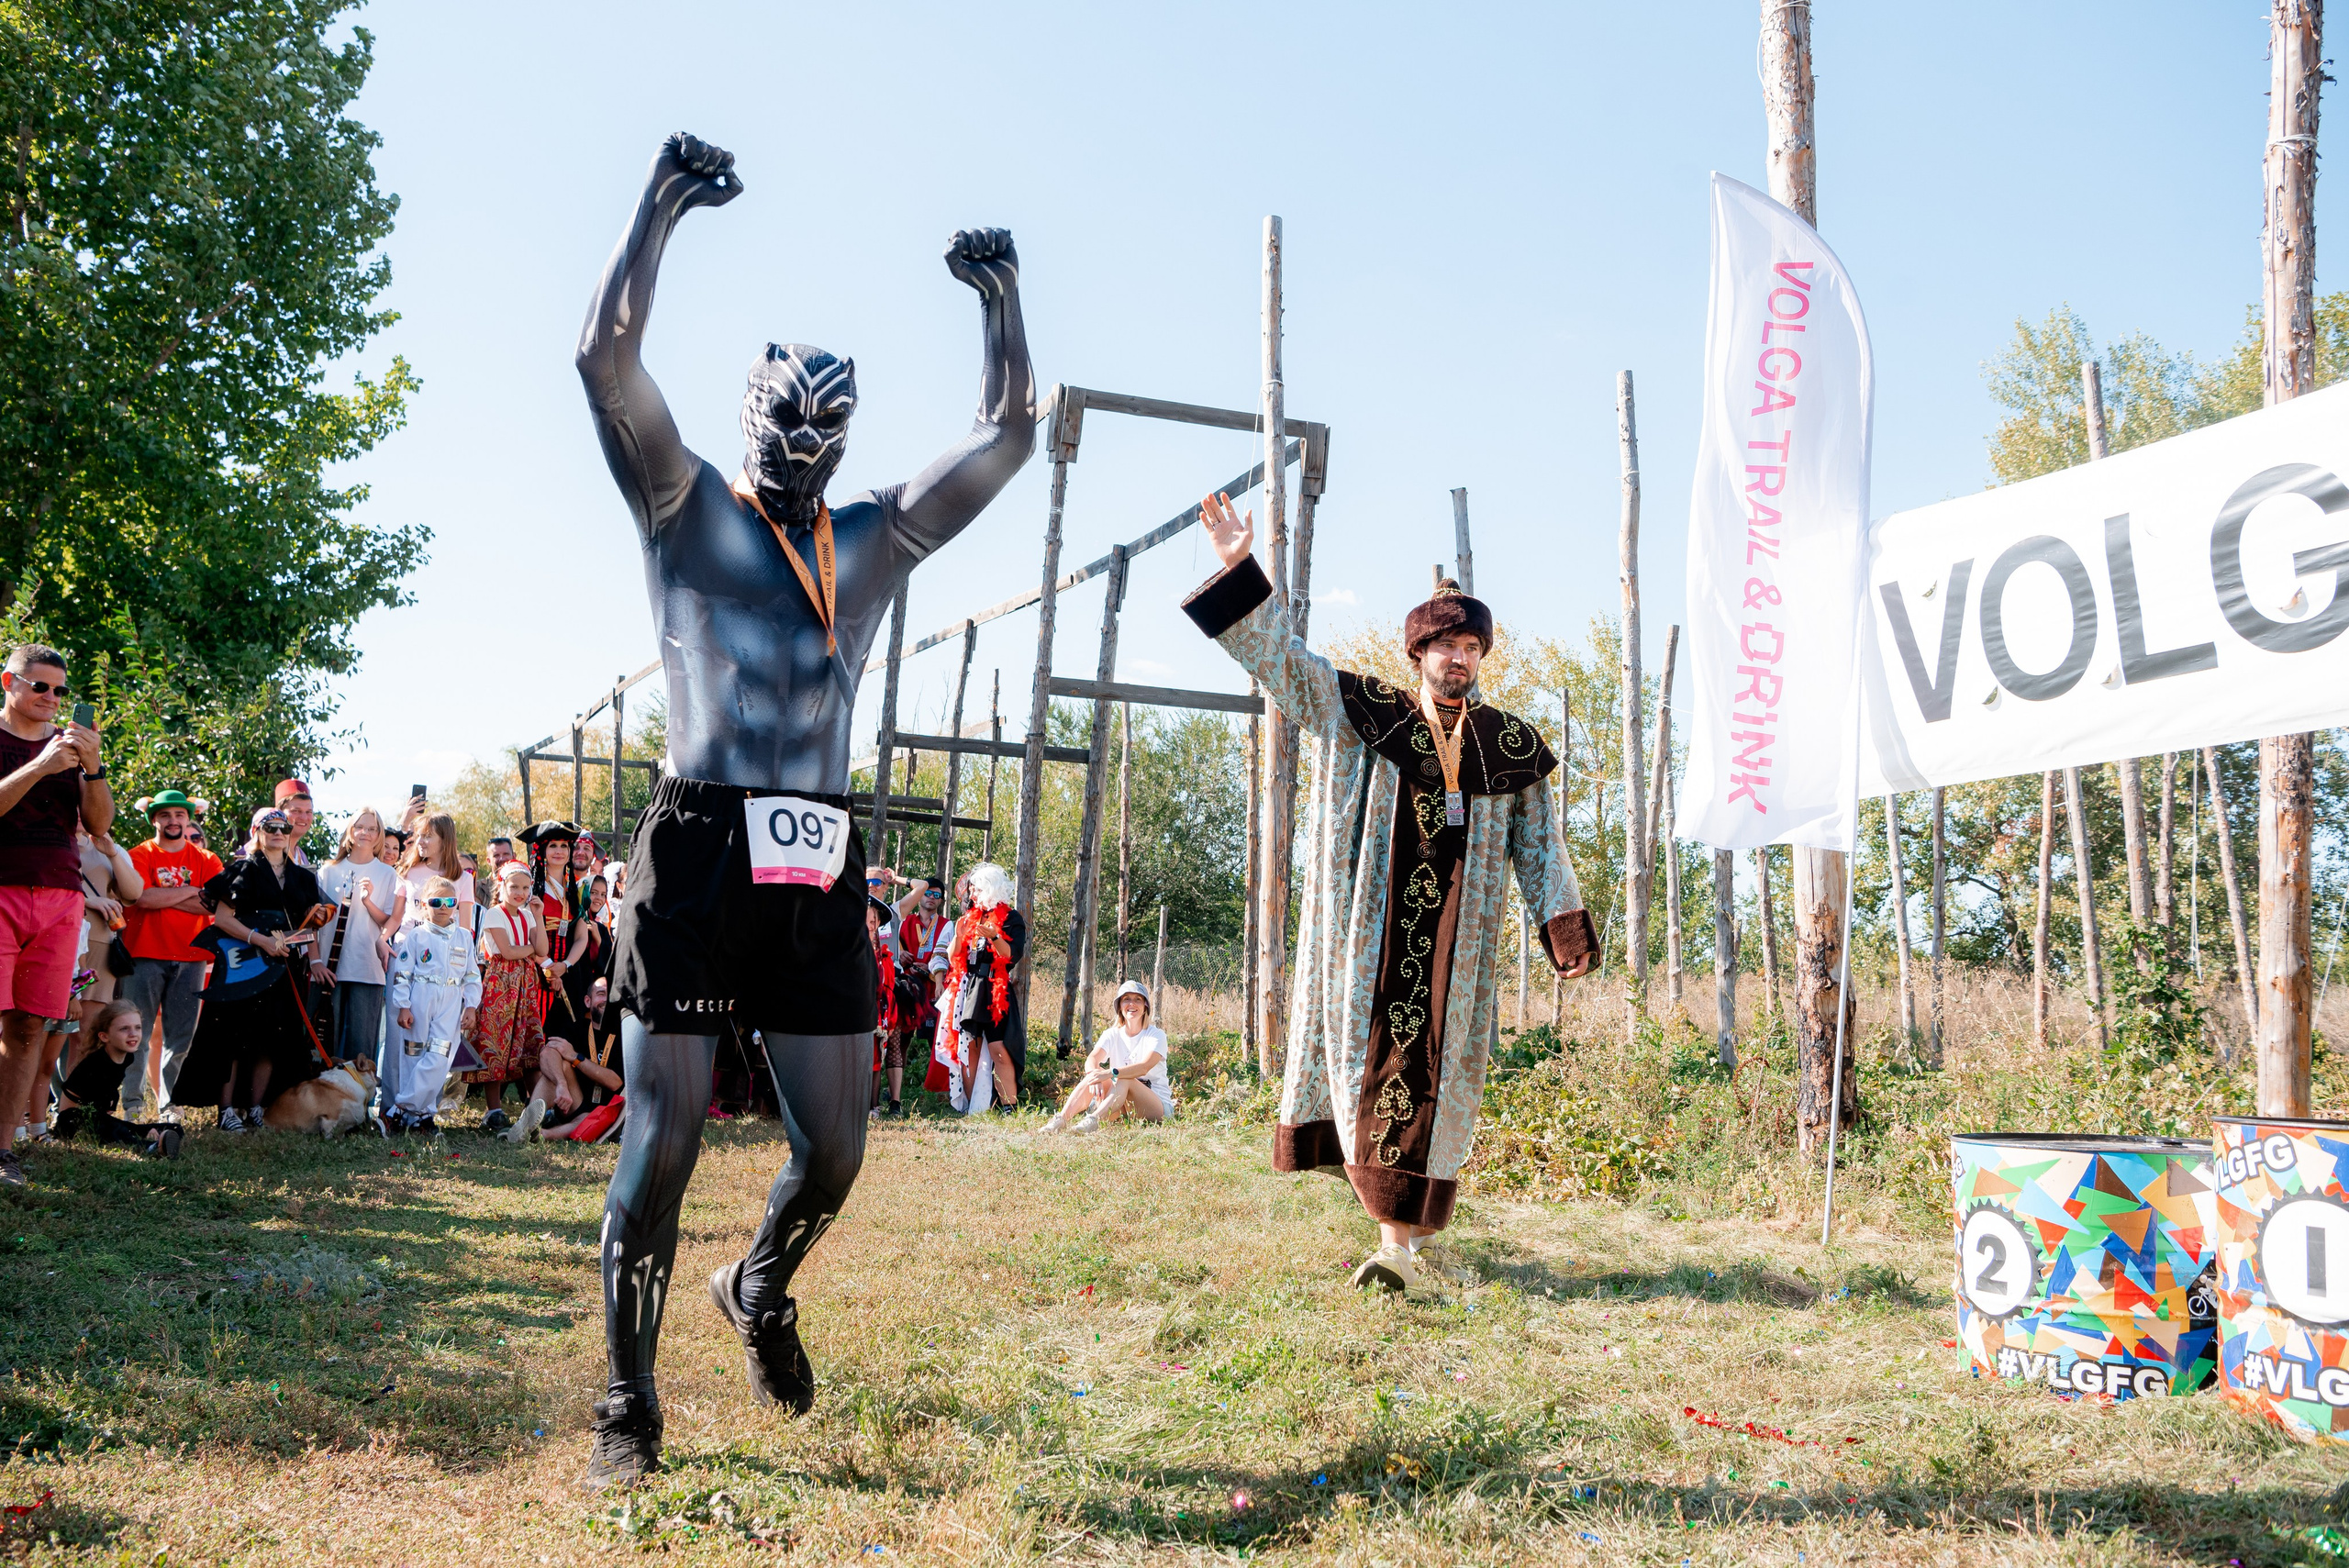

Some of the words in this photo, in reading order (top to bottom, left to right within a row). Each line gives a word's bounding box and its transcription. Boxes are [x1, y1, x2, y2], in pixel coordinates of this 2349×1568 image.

[1751, 261, 1814, 417] VOLGA
[1745, 429, 1791, 565] TRAIL
[821, 542, 830, 569] DRINK
[1742, 577, 1783, 610] &
[1878, 462, 2349, 723] VOLG
[1433, 723, 1442, 740] DRINK
[1727, 621, 1785, 815] DRINK
[1440, 745, 1448, 762] TRAIL
[1445, 763, 1453, 784] VOLGA
[769, 808, 841, 854] 097
[1976, 1233, 2008, 1296] 2
[1997, 1345, 2168, 1398] #VLGFG
[2243, 1350, 2349, 1407] #VLG
